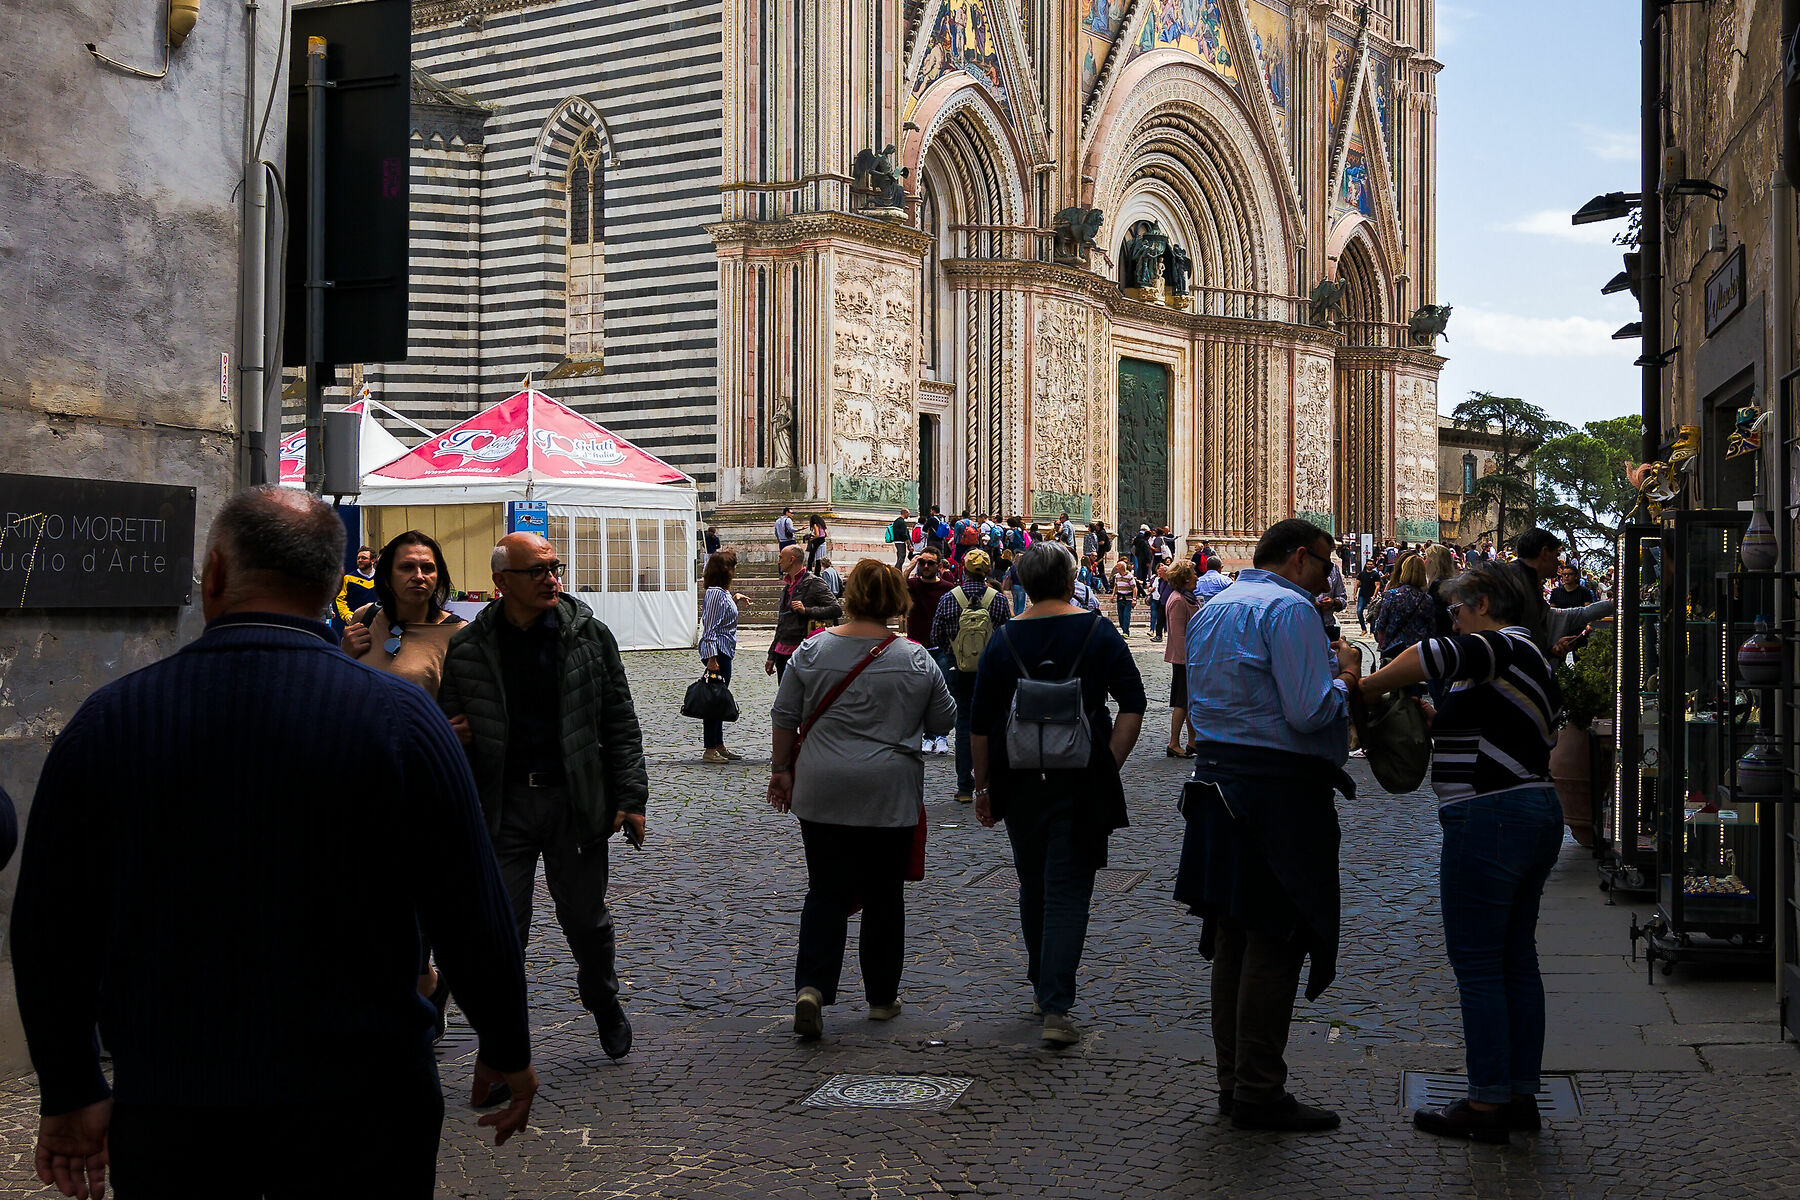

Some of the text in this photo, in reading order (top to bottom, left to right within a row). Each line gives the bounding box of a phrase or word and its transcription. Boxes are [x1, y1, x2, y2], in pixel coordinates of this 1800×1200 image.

[575, 439, 614, 452] Gelati
[72, 515, 166, 543] MORETTI
[82, 547, 166, 573] d'Arte
